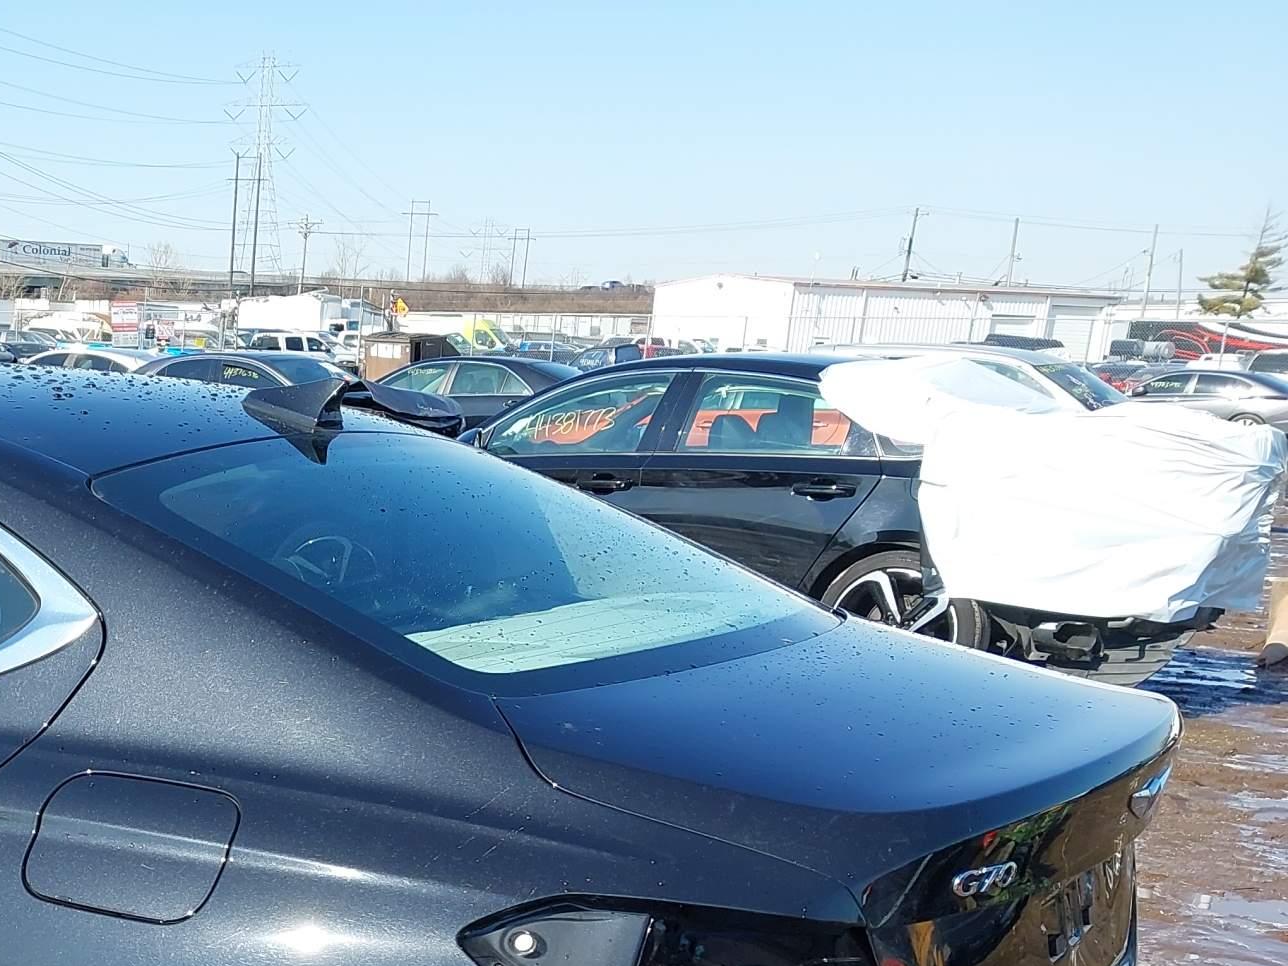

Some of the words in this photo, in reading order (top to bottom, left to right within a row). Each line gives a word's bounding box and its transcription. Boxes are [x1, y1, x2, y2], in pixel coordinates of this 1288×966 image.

[22, 244, 72, 257] Colonial
[526, 406, 617, 440] 44381773
[952, 861, 1018, 897] G70
